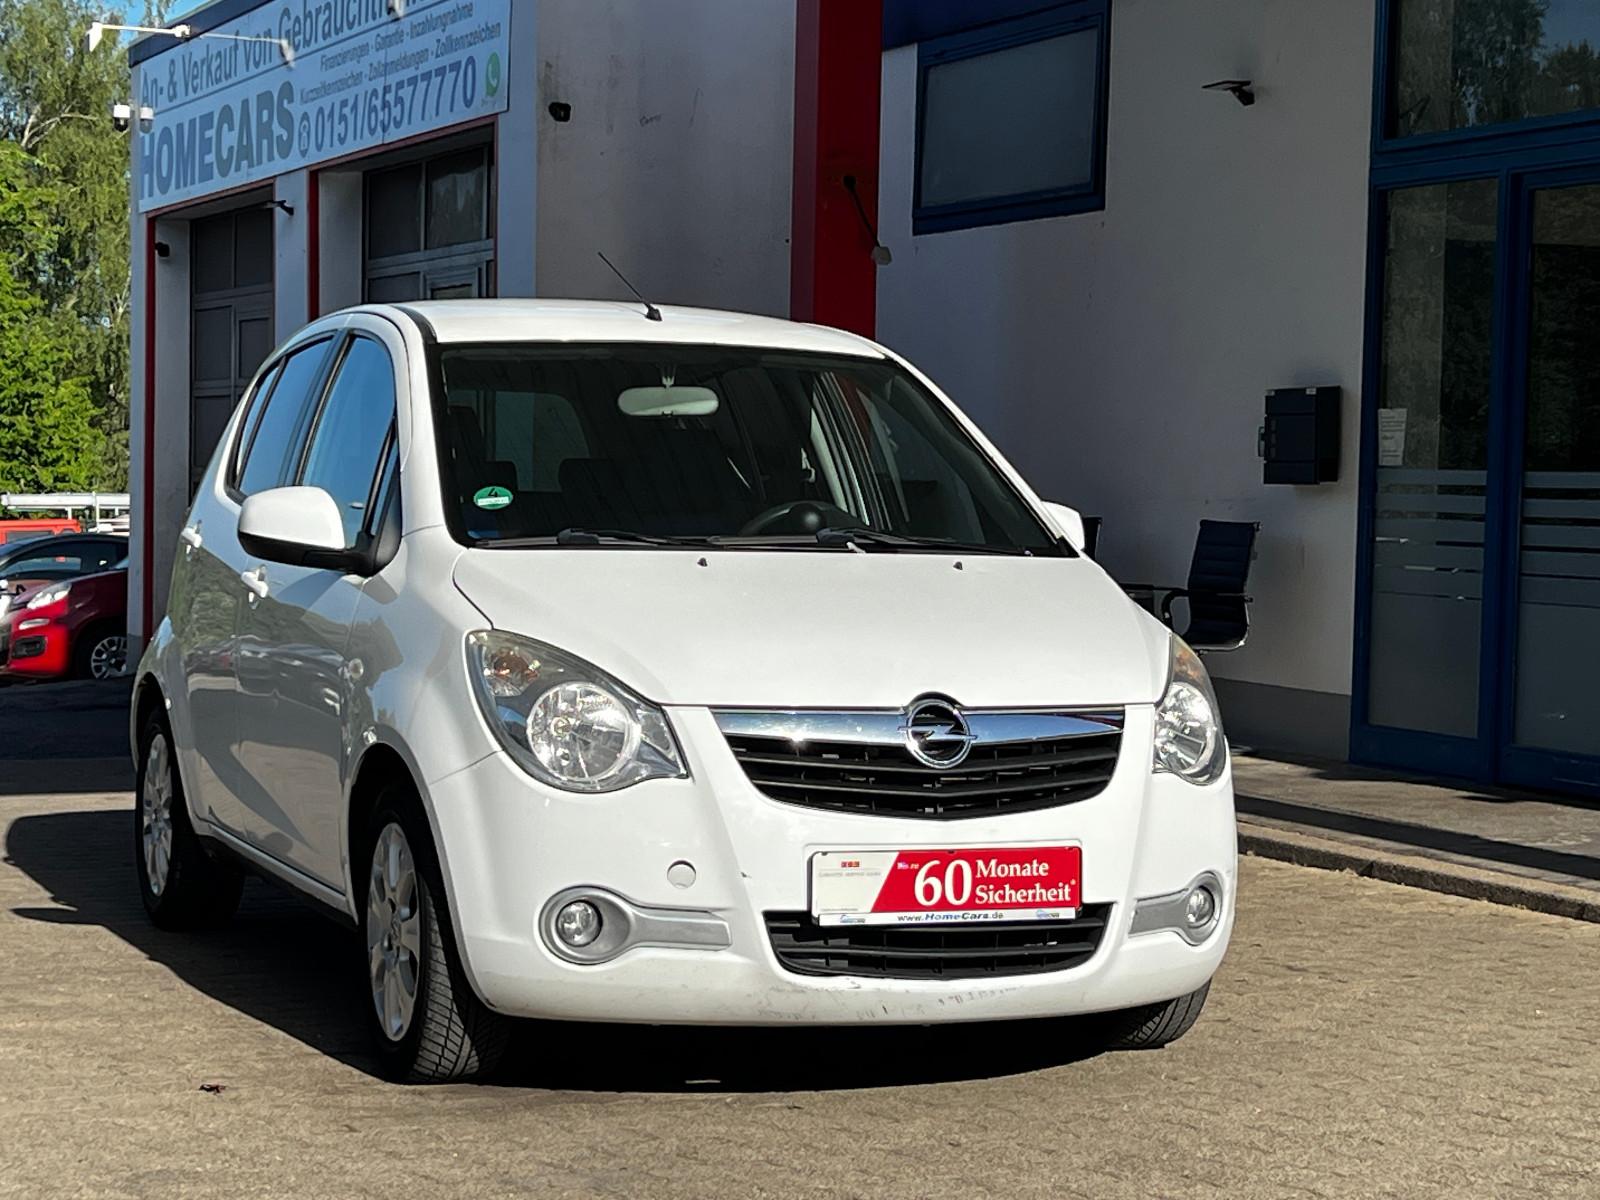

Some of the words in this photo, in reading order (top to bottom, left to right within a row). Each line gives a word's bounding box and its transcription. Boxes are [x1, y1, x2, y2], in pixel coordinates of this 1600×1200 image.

[375, 27, 404, 52] Garantie
[410, 2, 473, 40] Inzahlungnahme
[435, 21, 501, 59] Zollkennzeichen
[167, 59, 177, 103] &
[182, 29, 240, 97] Verkauf
[243, 28, 272, 73] von
[314, 55, 477, 152] 0151/65577770
[140, 81, 295, 201] HOMECARS
[487, 487, 498, 498] 4
[914, 859, 973, 907] 60
[976, 858, 1049, 878] Monate
[897, 911, 1004, 922] www.HomeCars.de
